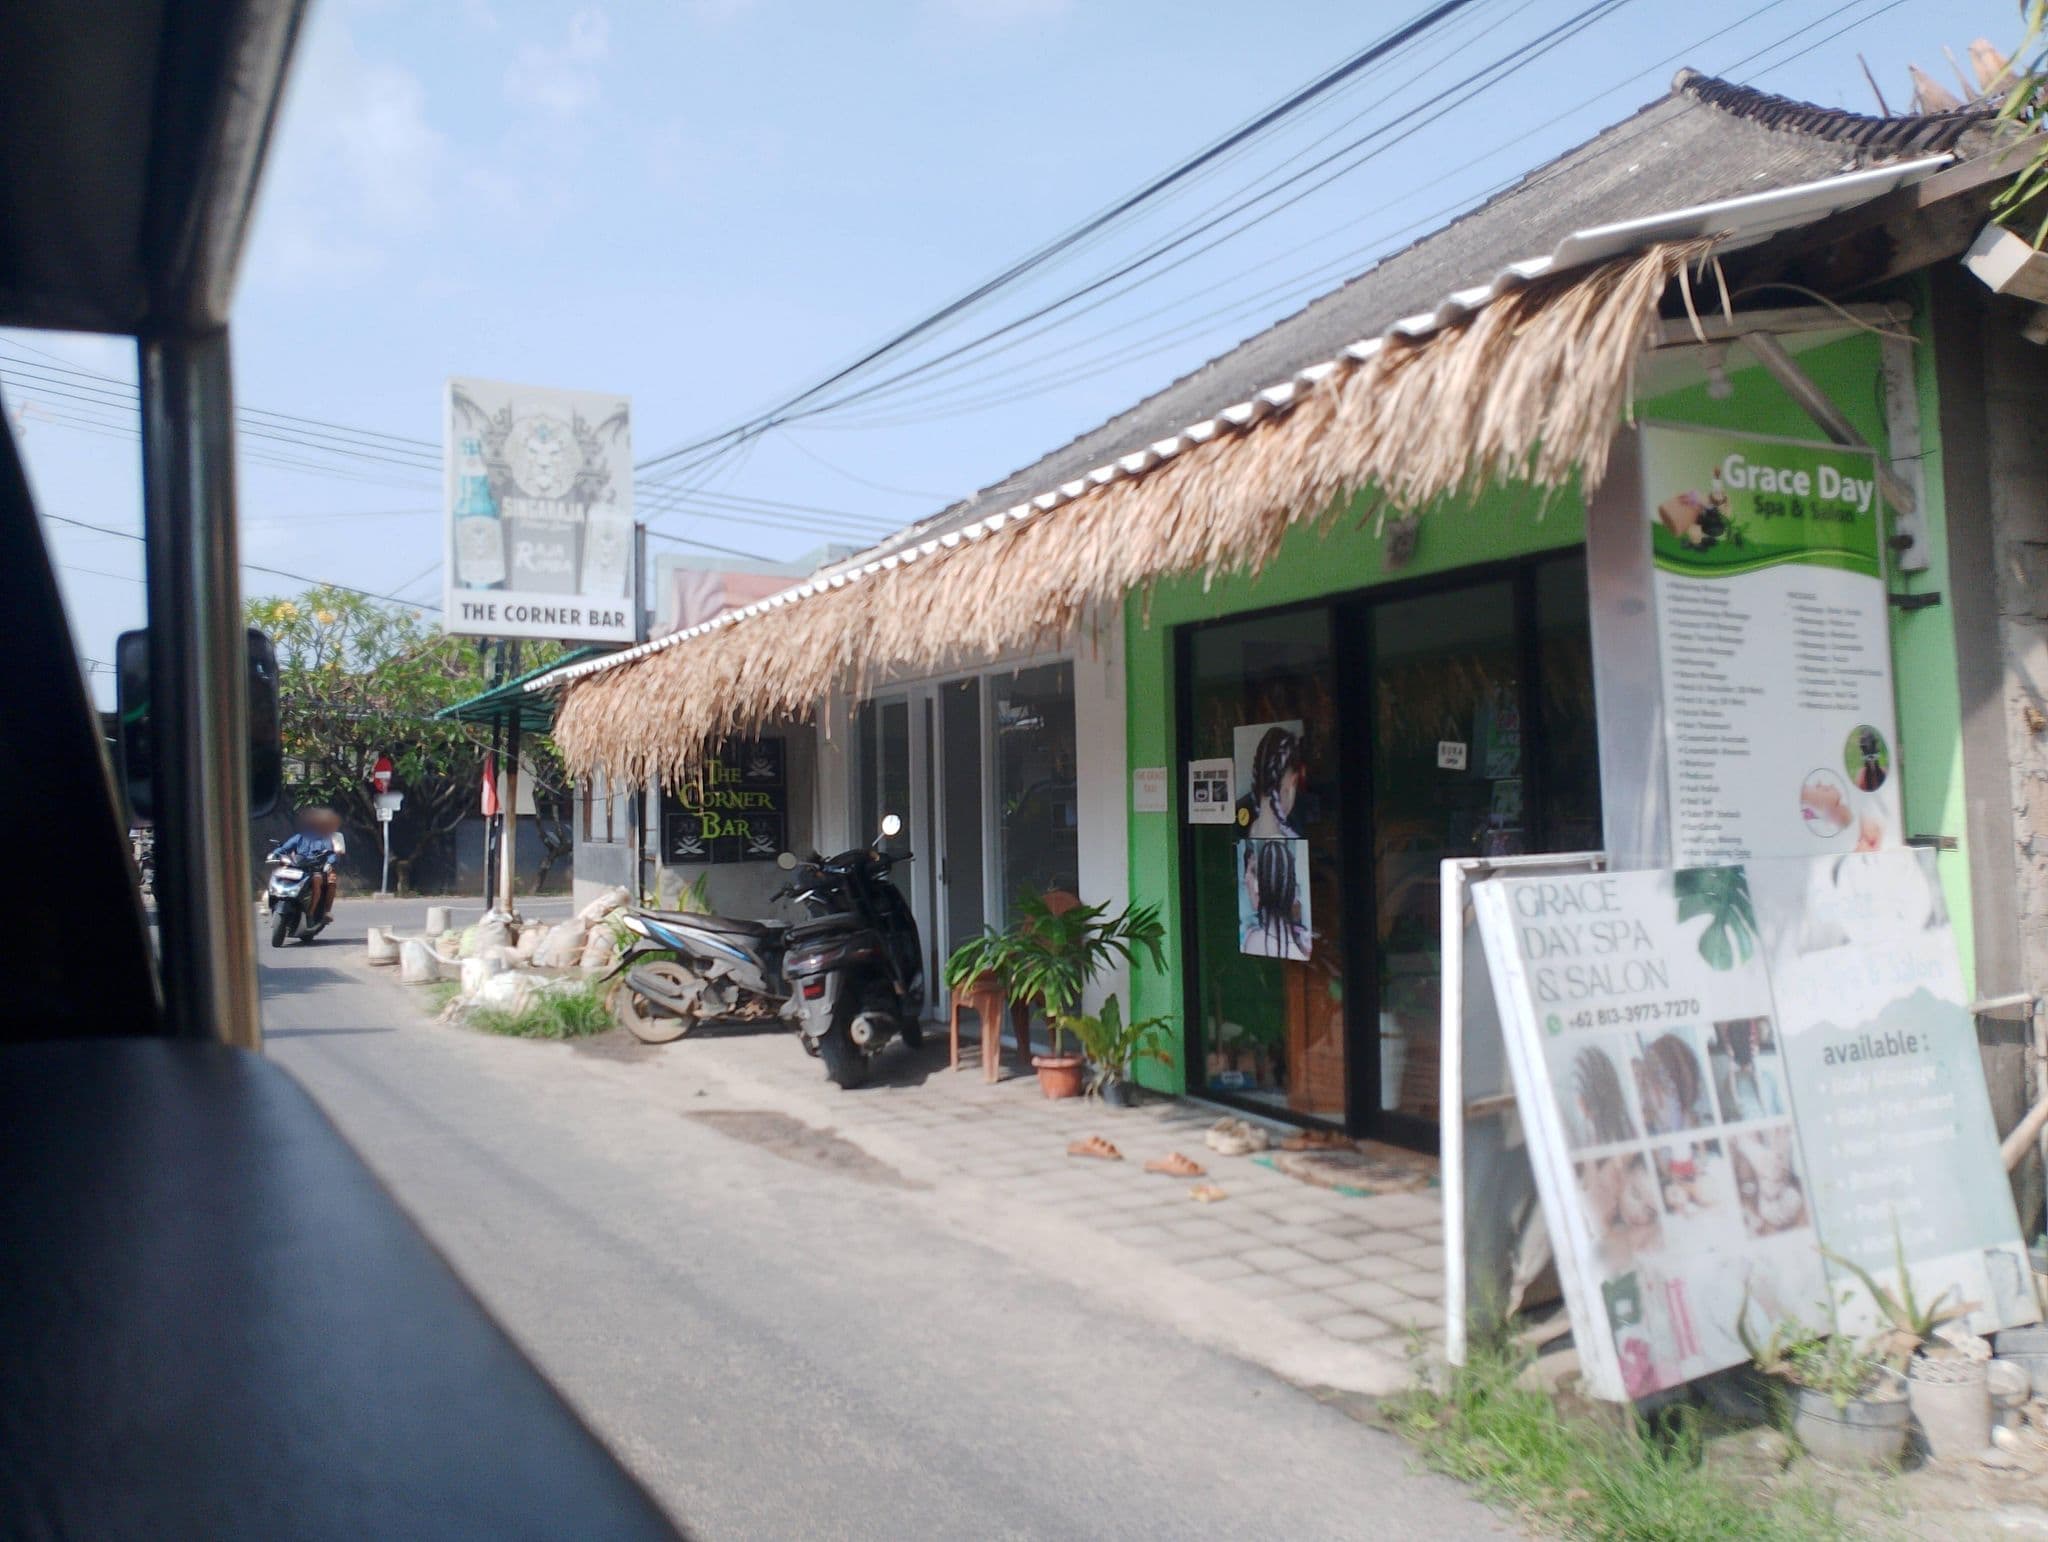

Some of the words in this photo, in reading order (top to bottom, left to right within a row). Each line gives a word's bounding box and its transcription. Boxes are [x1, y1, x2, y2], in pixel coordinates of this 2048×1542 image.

[1723, 453, 1812, 497] Grace
[1817, 463, 1874, 514] Day
[1753, 495, 1786, 521] Spa
[1790, 496, 1804, 518] &
[461, 602, 498, 622] THE
[503, 604, 583, 626] CORNER
[588, 609, 627, 629] BAR
[1514, 878, 1623, 919] GRACE
[1523, 921, 1583, 960] DAY
[1588, 918, 1654, 955] SPA
[1536, 967, 1562, 1002] &
[1565, 957, 1671, 1001] SALON
